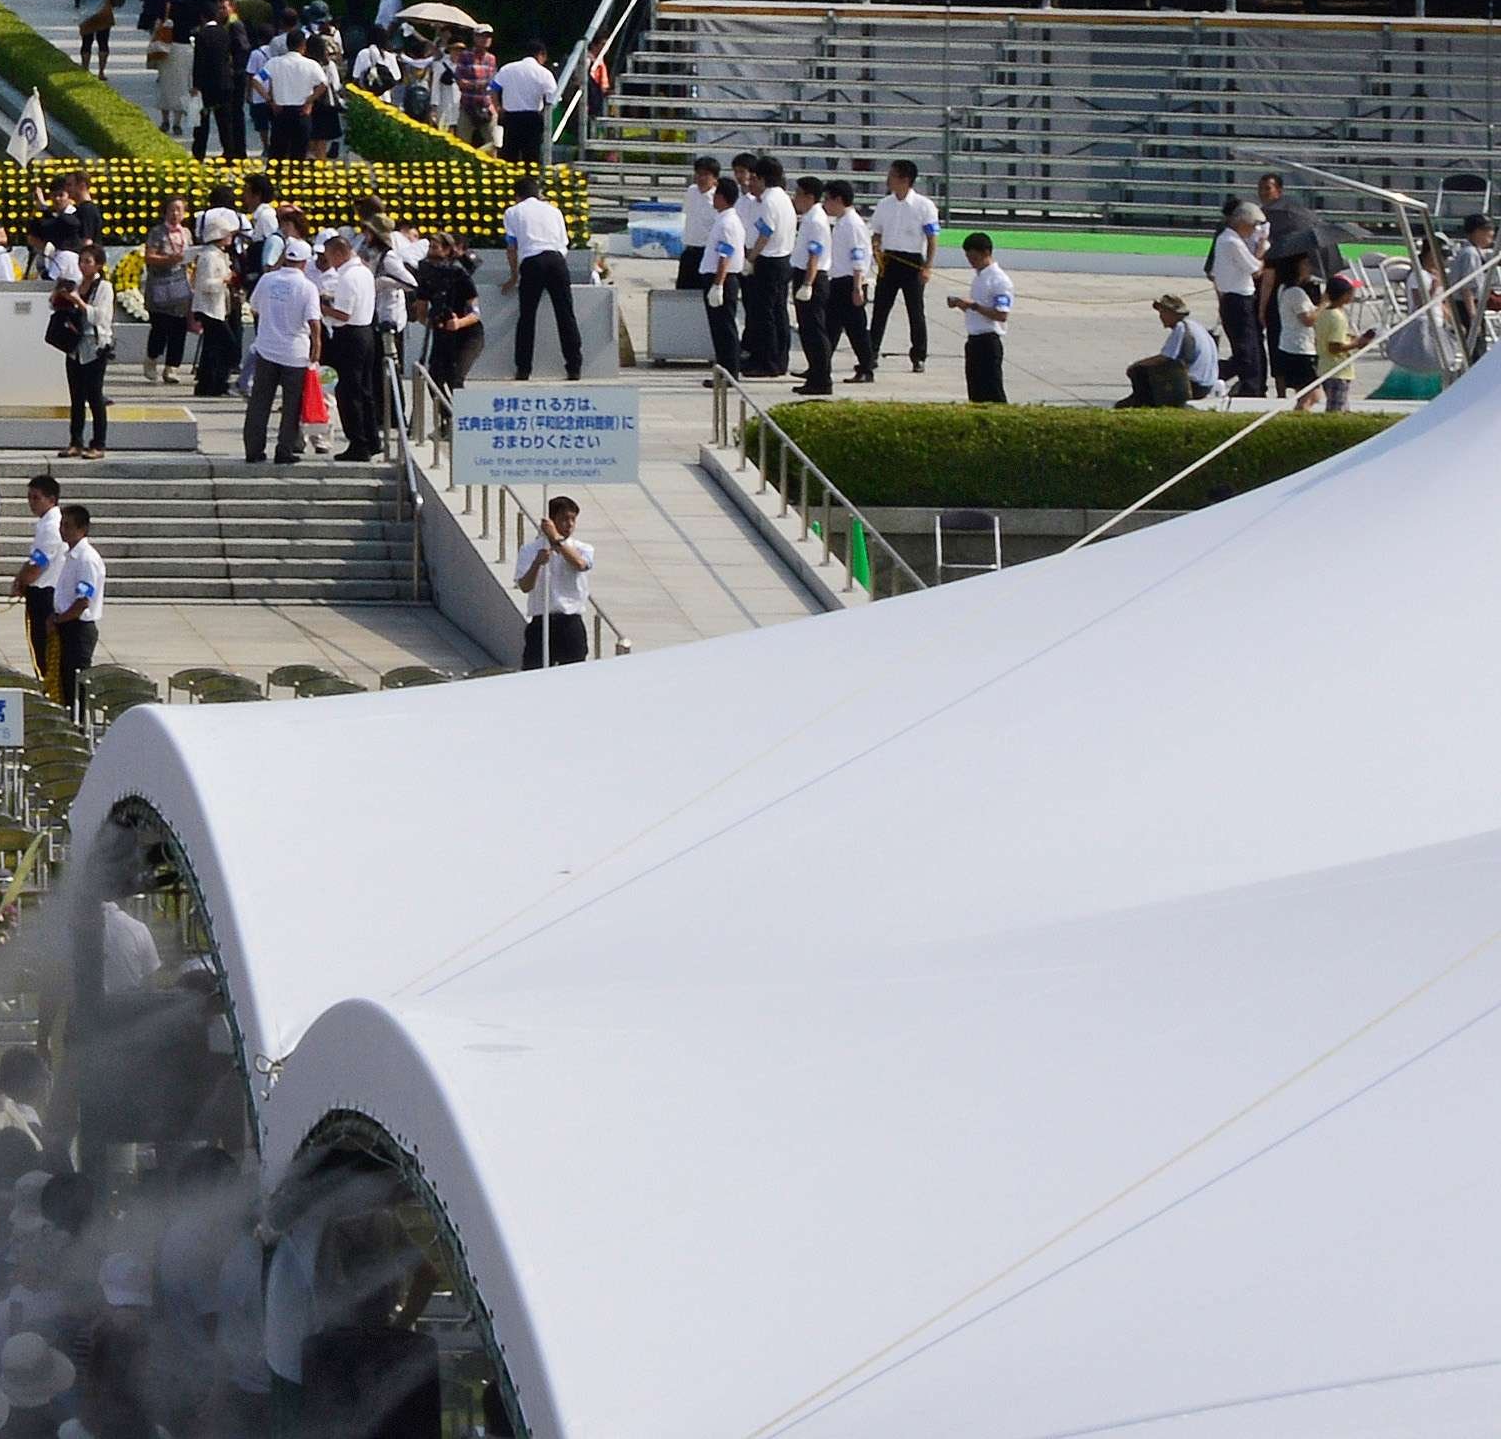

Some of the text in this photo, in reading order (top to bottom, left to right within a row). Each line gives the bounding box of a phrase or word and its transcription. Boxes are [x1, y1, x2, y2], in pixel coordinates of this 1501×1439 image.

[492, 397, 597, 412] 参拝される方は、
[492, 434, 601, 449] おまわりください
[474, 457, 494, 465] Use
[497, 457, 512, 465] the
[575, 457, 591, 465] the
